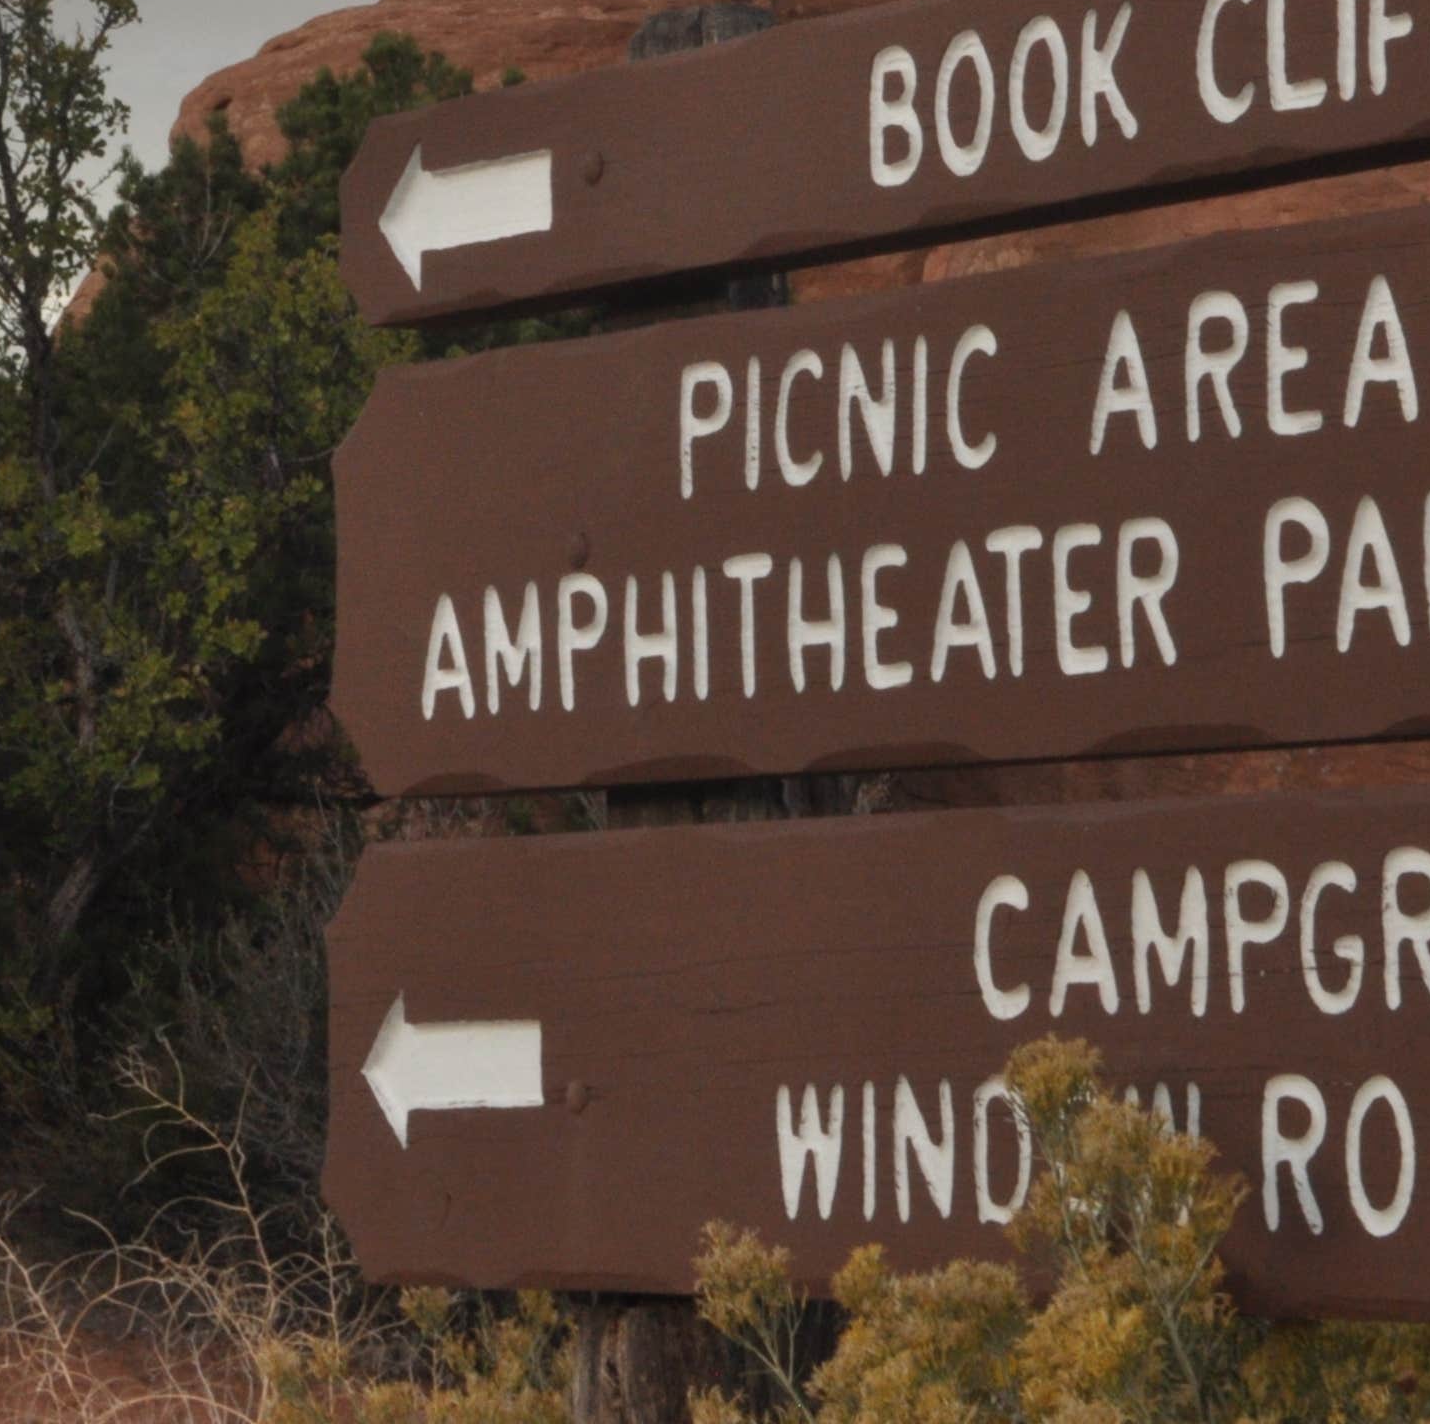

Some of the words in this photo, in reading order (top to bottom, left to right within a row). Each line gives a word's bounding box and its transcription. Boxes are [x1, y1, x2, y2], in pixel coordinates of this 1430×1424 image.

[868, 6, 1139, 189] BOOK
[678, 324, 998, 500] PICNIC
[1089, 276, 1420, 456] AREA
[420, 516, 1180, 722] AMPHITHEATER
[775, 1076, 1202, 1226] WIND
